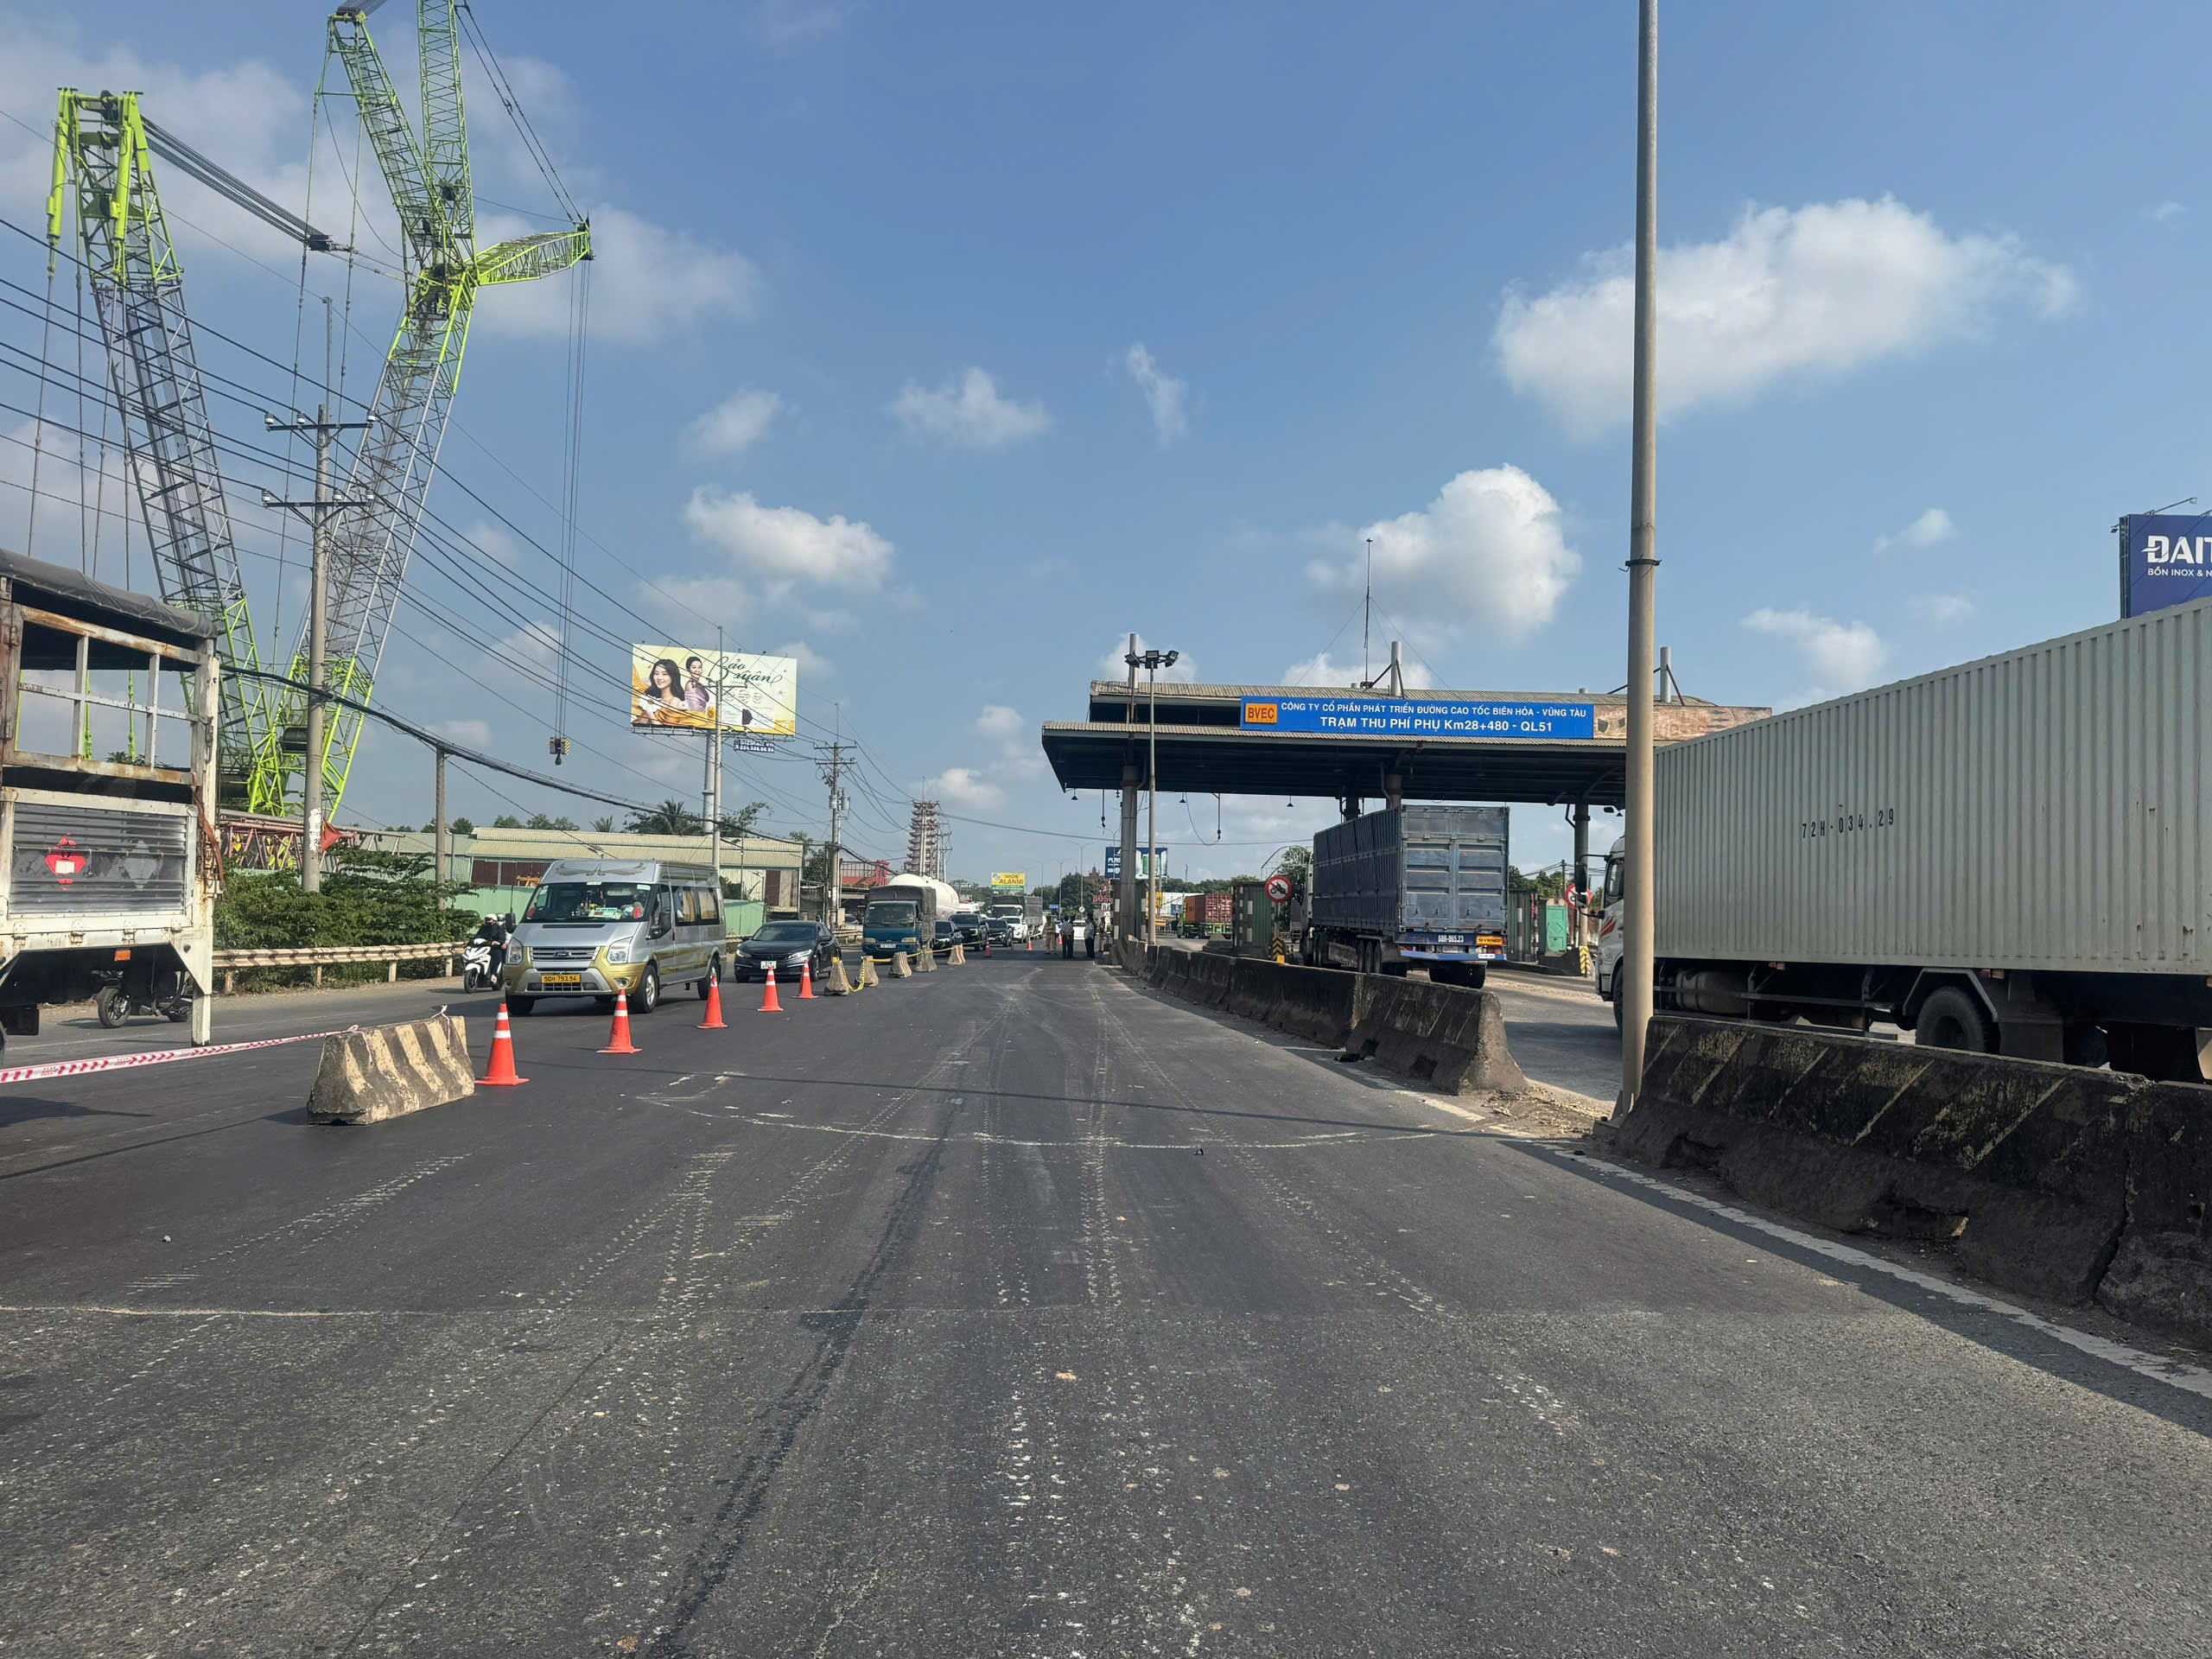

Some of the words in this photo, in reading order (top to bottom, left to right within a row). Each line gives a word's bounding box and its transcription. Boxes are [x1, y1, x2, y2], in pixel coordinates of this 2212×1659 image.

[2171, 568, 2195, 577] INOX
[1247, 707, 1275, 720] BVEC
[1281, 701, 1306, 711] CÔNG
[1322, 701, 1335, 712] CỔ
[1363, 703, 1387, 714] PHÁT
[1389, 702, 1414, 714] TRIỂN
[1417, 704, 1449, 715] ĐƯỜNG
[1450, 706, 1470, 715] CAO
[1471, 704, 1491, 715] TỐC
[1492, 705, 1514, 716] BIÊN
[1515, 706, 1535, 716] HÒA
[1541, 707, 1567, 717] VŨNG
[1569, 708, 1586, 718] TÀU
[1320, 716, 1357, 729] TRẠM
[1360, 717, 1387, 728] THU
[1389, 716, 1411, 729] PHÍ
[1414, 719, 1440, 733] PHỤ
[1444, 719, 1510, 732] Km28+480
[1520, 721, 1553, 733] QL51
